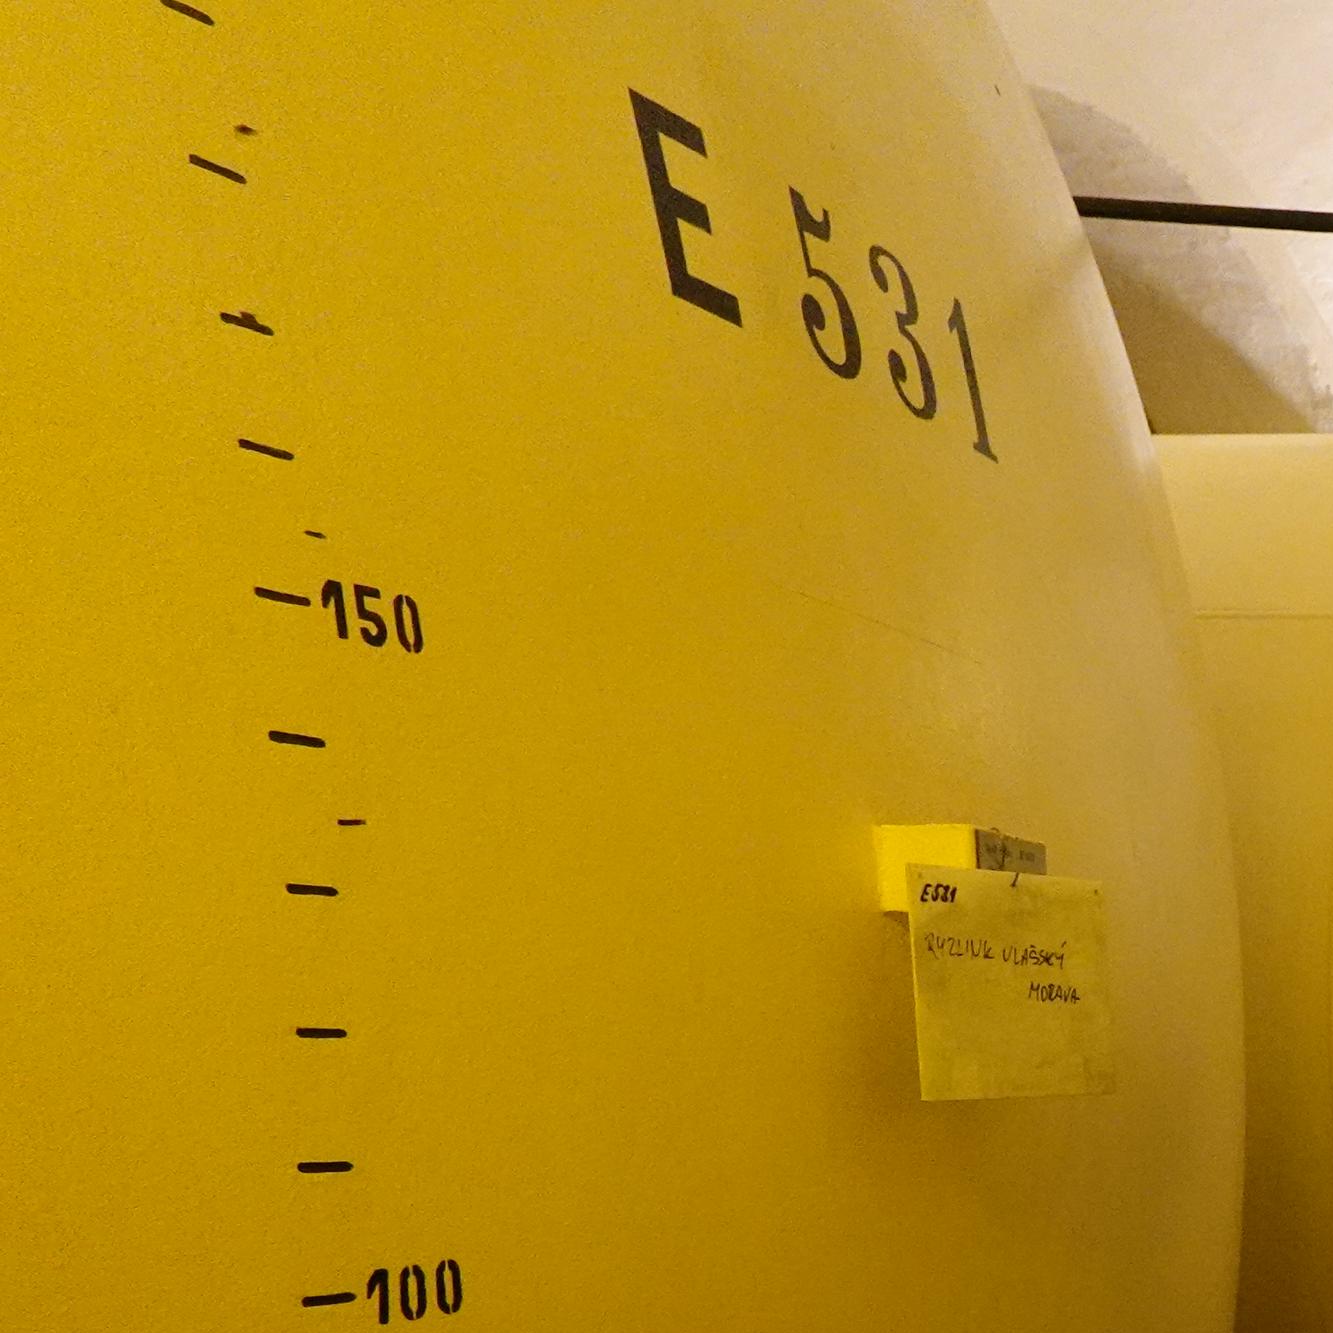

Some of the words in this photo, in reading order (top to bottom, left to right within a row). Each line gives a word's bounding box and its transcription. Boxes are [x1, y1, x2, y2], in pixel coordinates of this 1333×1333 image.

[627, 87, 743, 329] E
[788, 185, 999, 464] 531
[320, 578, 425, 655] 150
[1027, 980, 1081, 1006] MORAVA
[365, 1258, 464, 1325] 100
